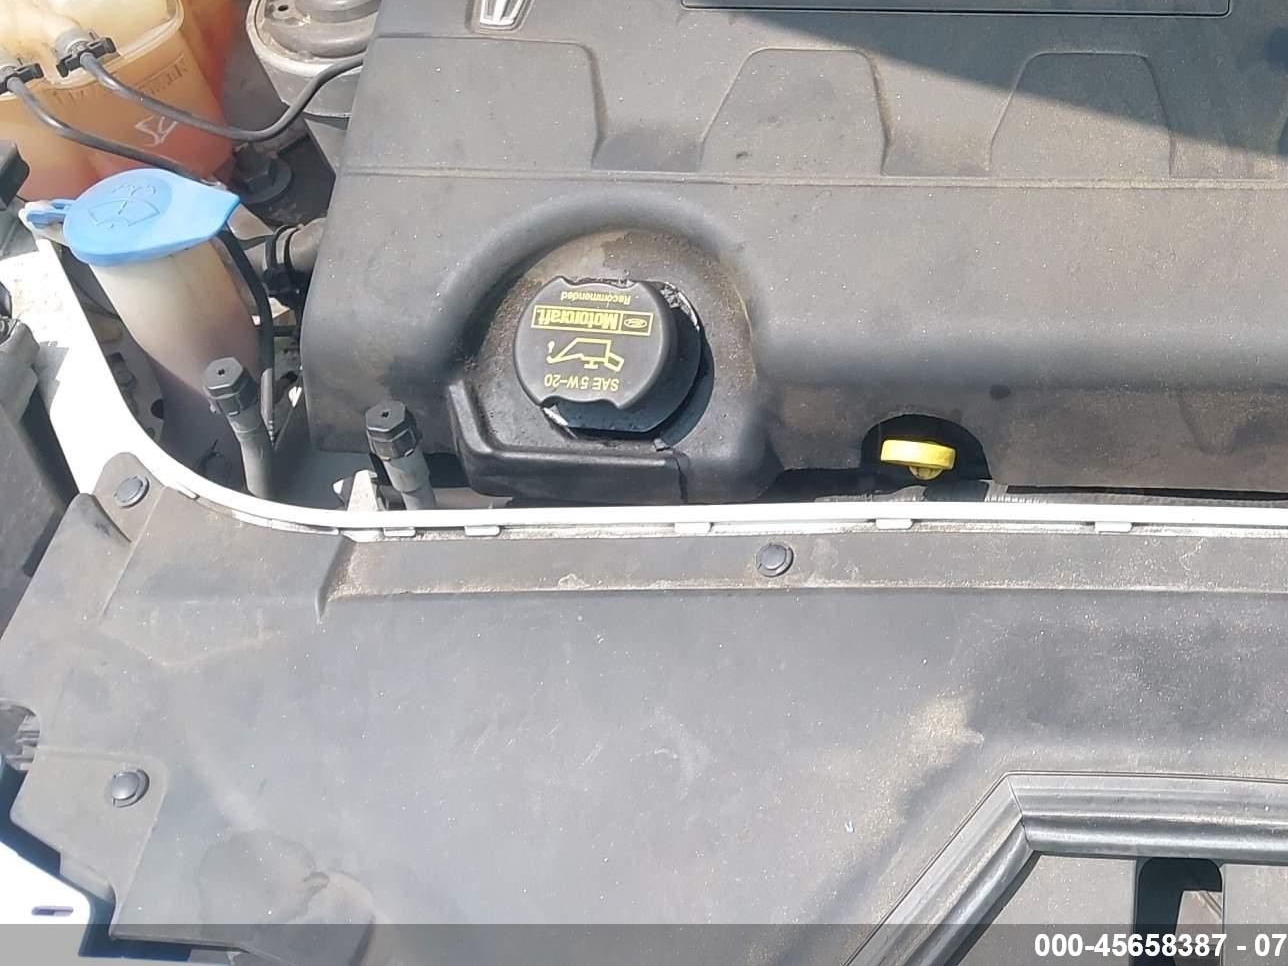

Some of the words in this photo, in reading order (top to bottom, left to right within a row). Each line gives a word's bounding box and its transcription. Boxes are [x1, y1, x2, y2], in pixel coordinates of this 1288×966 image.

[560, 290, 632, 306] Recommended
[540, 308, 619, 331] Motorcraft
[543, 373, 588, 390] 5W-20
[592, 377, 619, 392] SAE
